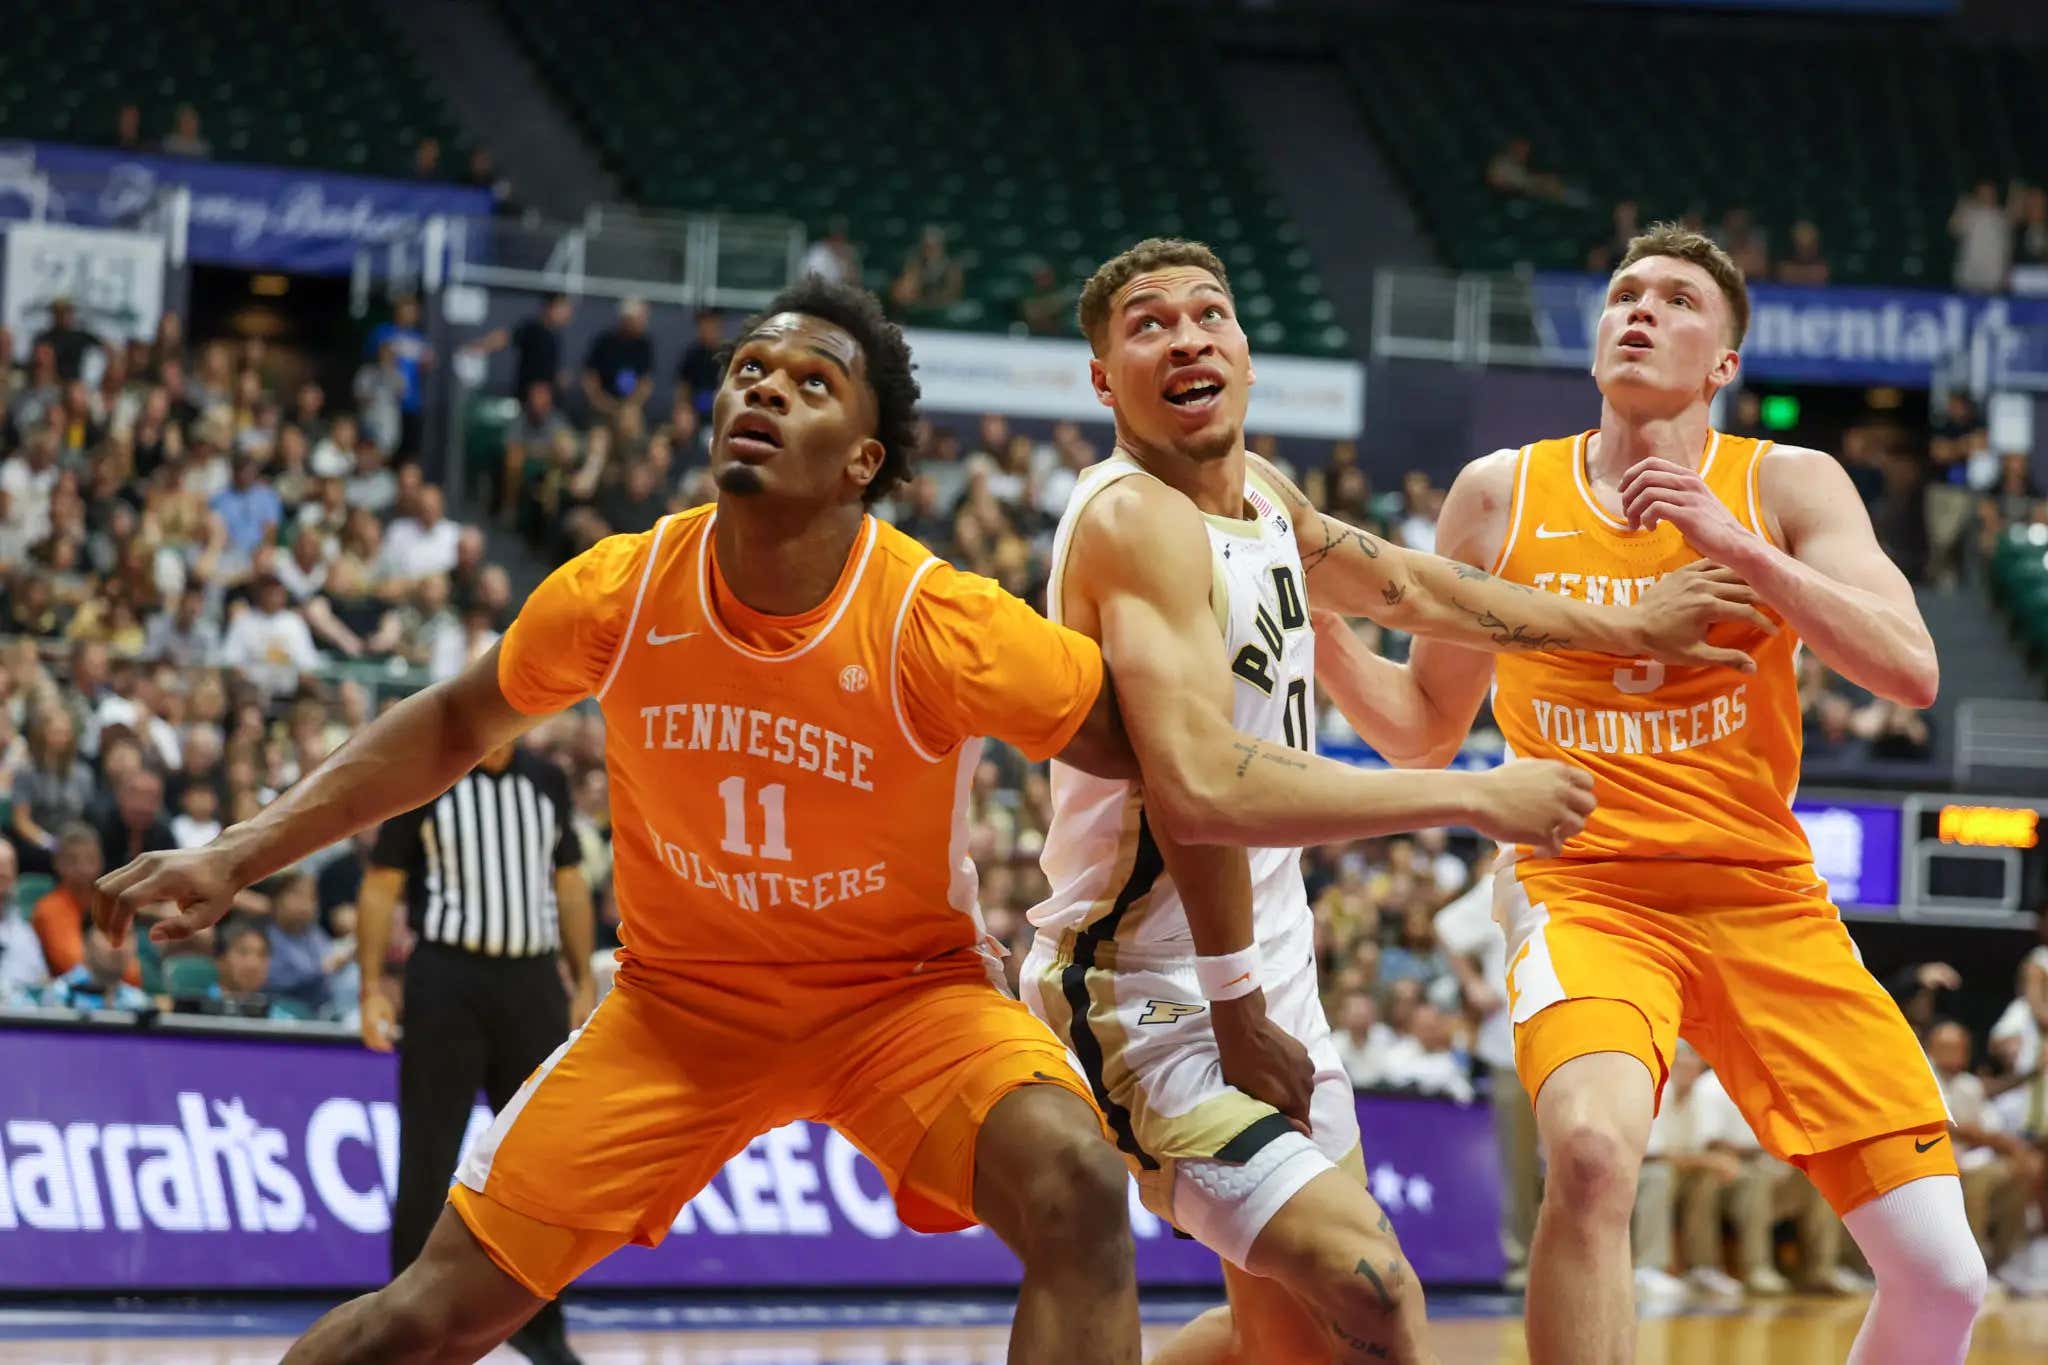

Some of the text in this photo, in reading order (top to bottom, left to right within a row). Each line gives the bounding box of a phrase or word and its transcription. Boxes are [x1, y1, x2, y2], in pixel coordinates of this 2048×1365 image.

[1757, 292, 1967, 362] nental
[1231, 565, 1307, 696] PUD
[640, 703, 874, 792] TENNESSEE
[1531, 684, 1748, 754] VOLUNTEERS
[717, 775, 792, 861] 11
[0, 1091, 306, 1232] arrah's
